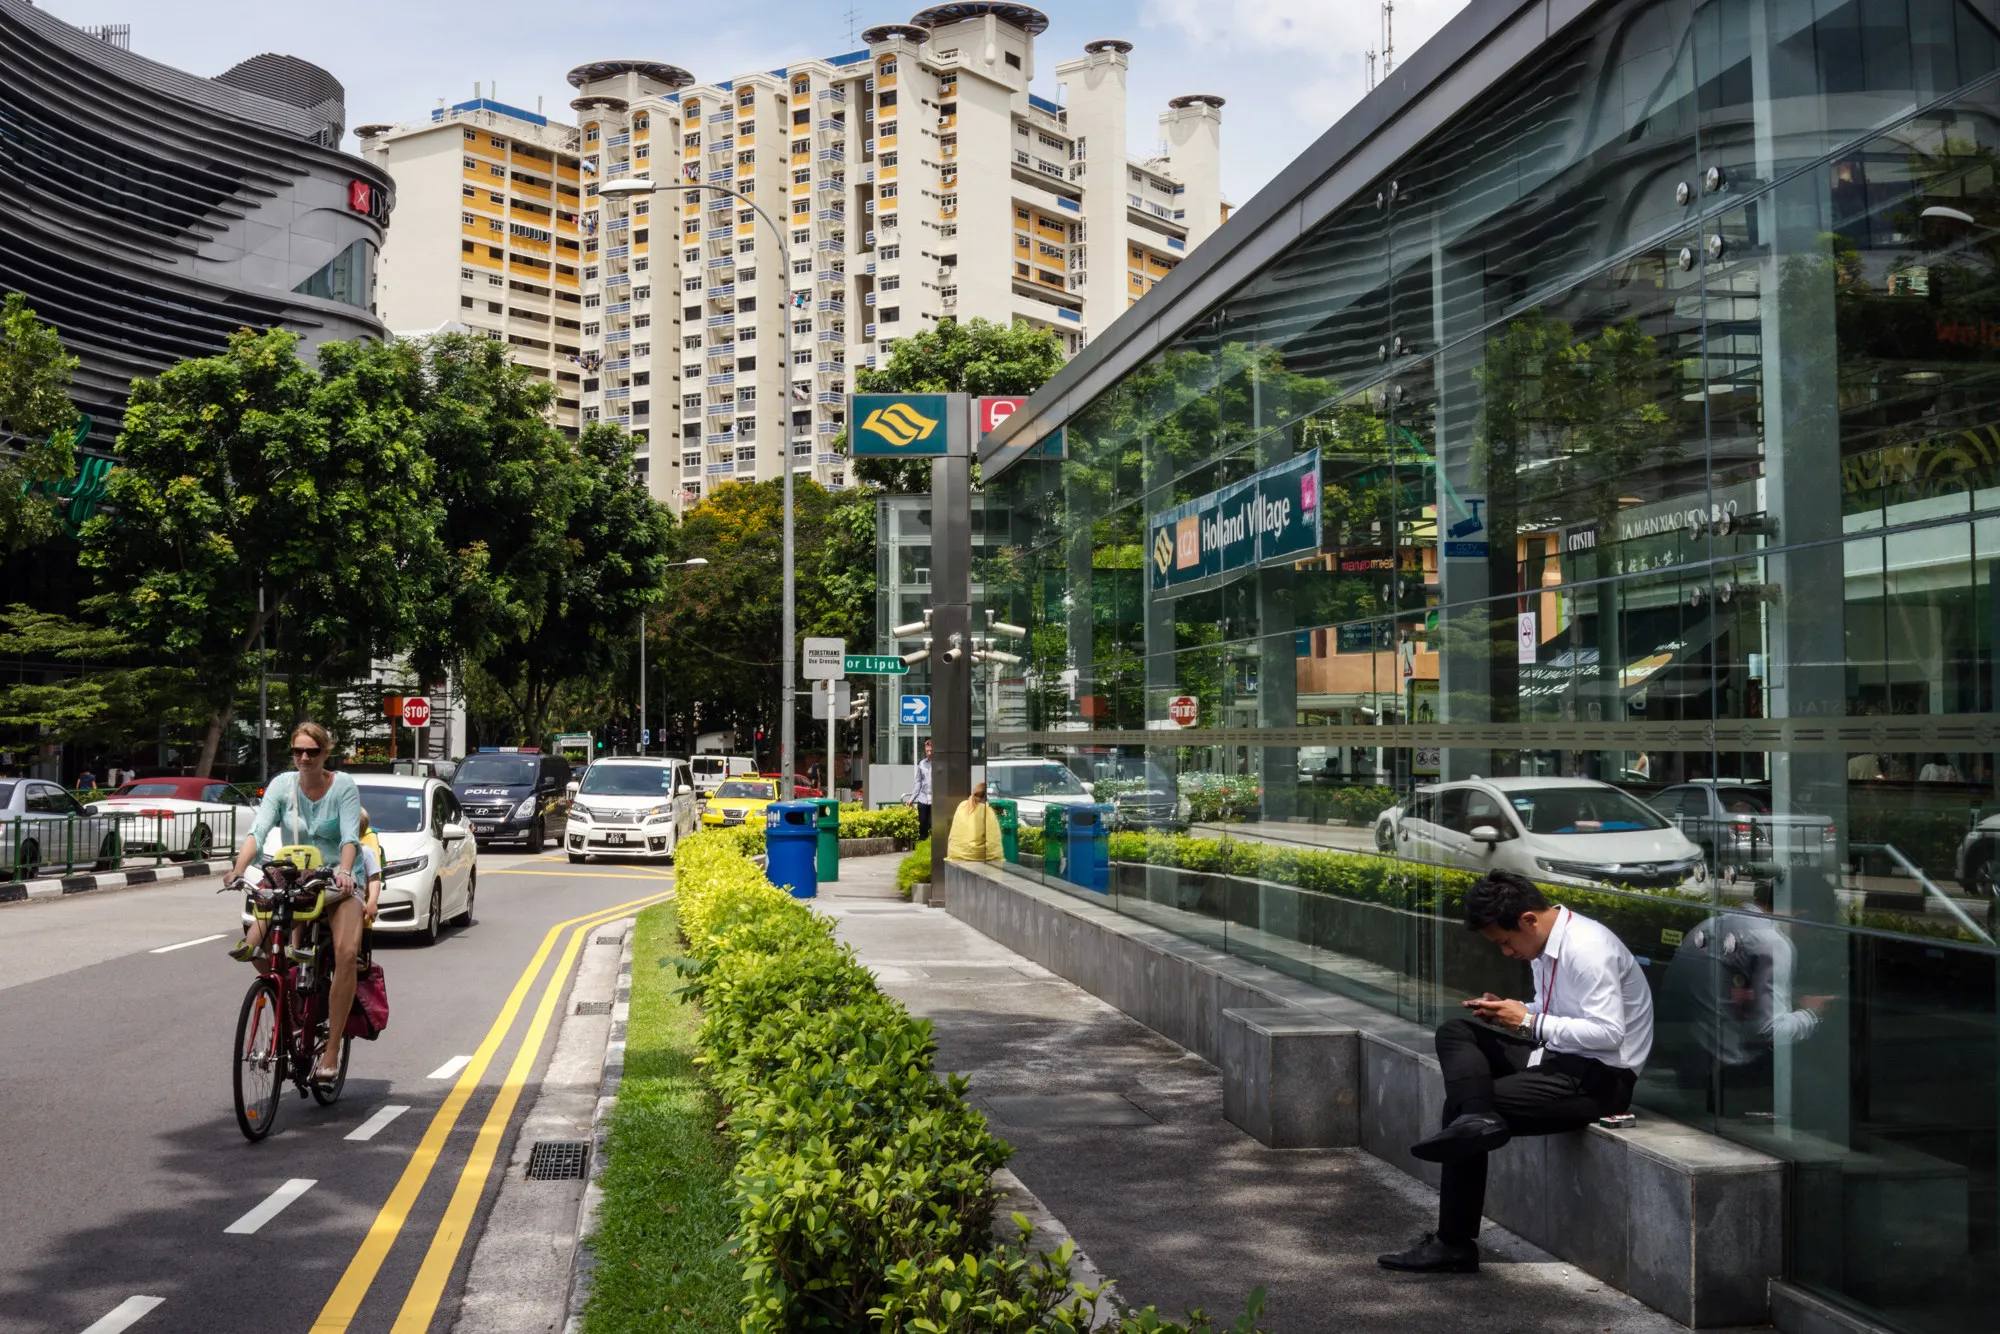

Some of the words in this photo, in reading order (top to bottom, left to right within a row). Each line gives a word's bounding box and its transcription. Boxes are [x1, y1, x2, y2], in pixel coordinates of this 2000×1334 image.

[372, 187, 390, 225] DB
[1202, 503, 1244, 552] Holland
[1247, 493, 1290, 537] Village
[1659, 511, 1683, 532] XIAO
[866, 658, 902, 671] Liput
[404, 706, 428, 718] STOP
[464, 788, 510, 796] POLICE
